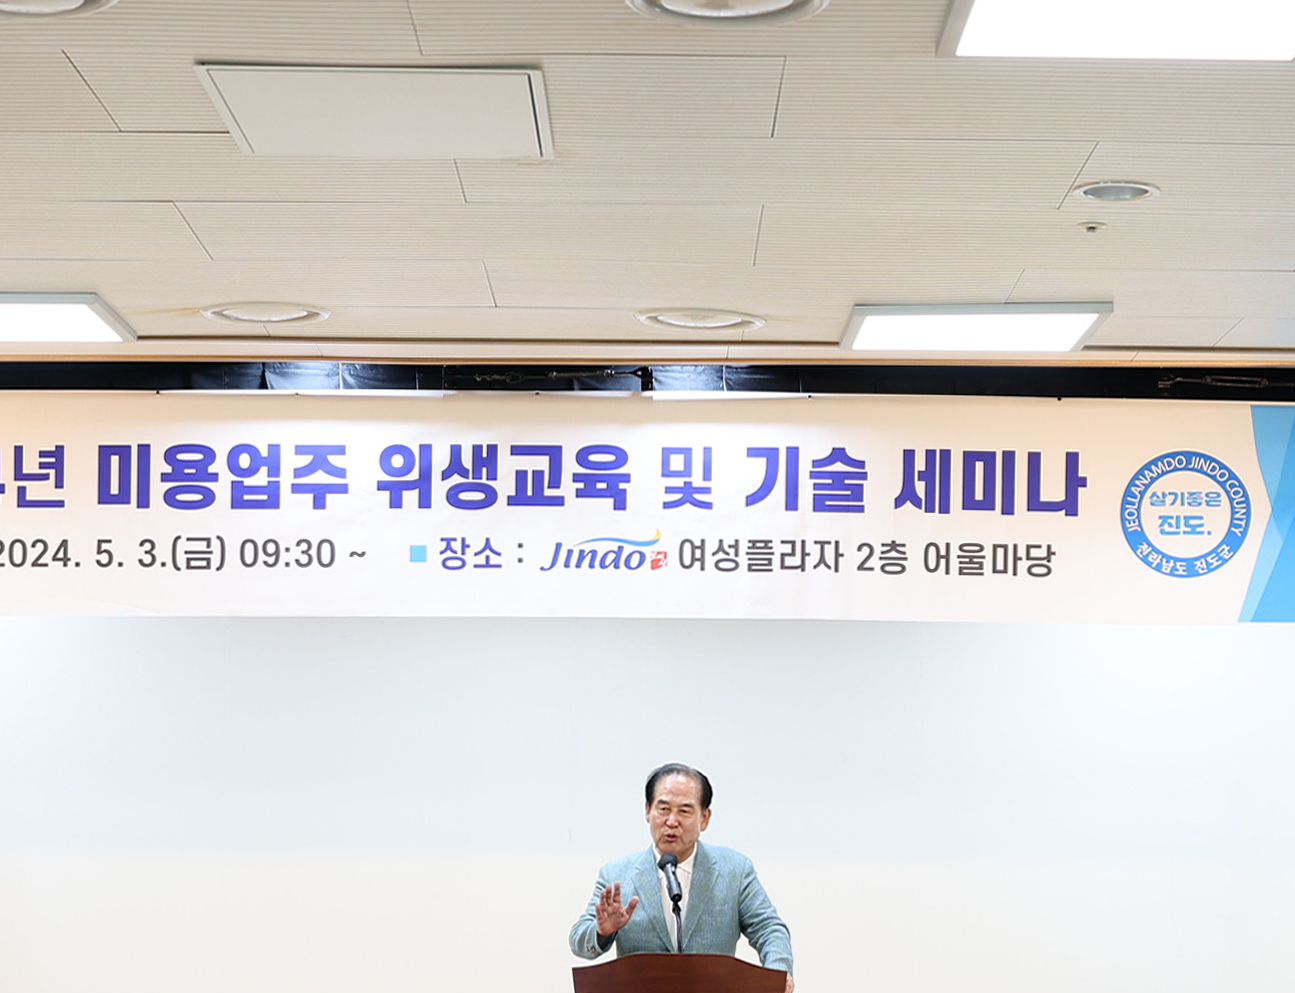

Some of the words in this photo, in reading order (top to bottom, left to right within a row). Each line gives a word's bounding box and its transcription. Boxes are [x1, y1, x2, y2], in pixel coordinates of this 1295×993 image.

[97, 444, 349, 510] 미용업주
[376, 444, 631, 510] 위생교육
[661, 446, 713, 510] 및
[745, 446, 868, 513] 기술
[894, 448, 1088, 516] 세미나
[1125, 455, 1187, 532] JEOLLANAMDO
[1188, 456, 1229, 481] JINDO
[1226, 479, 1248, 537] COUNTY
[1149, 491, 1222, 507] 살기좋은
[1158, 514, 1213, 536] 진도.
[95, 539, 124, 567] 5.
[138, 535, 226, 571] 3.(금)
[239, 538, 335, 567] 09:30
[439, 537, 502, 570] 장소
[539, 541, 647, 571] Jindo
[679, 538, 845, 573] 여성플라자
[856, 540, 908, 574] 2층
[923, 542, 1056, 577] 어울마당
